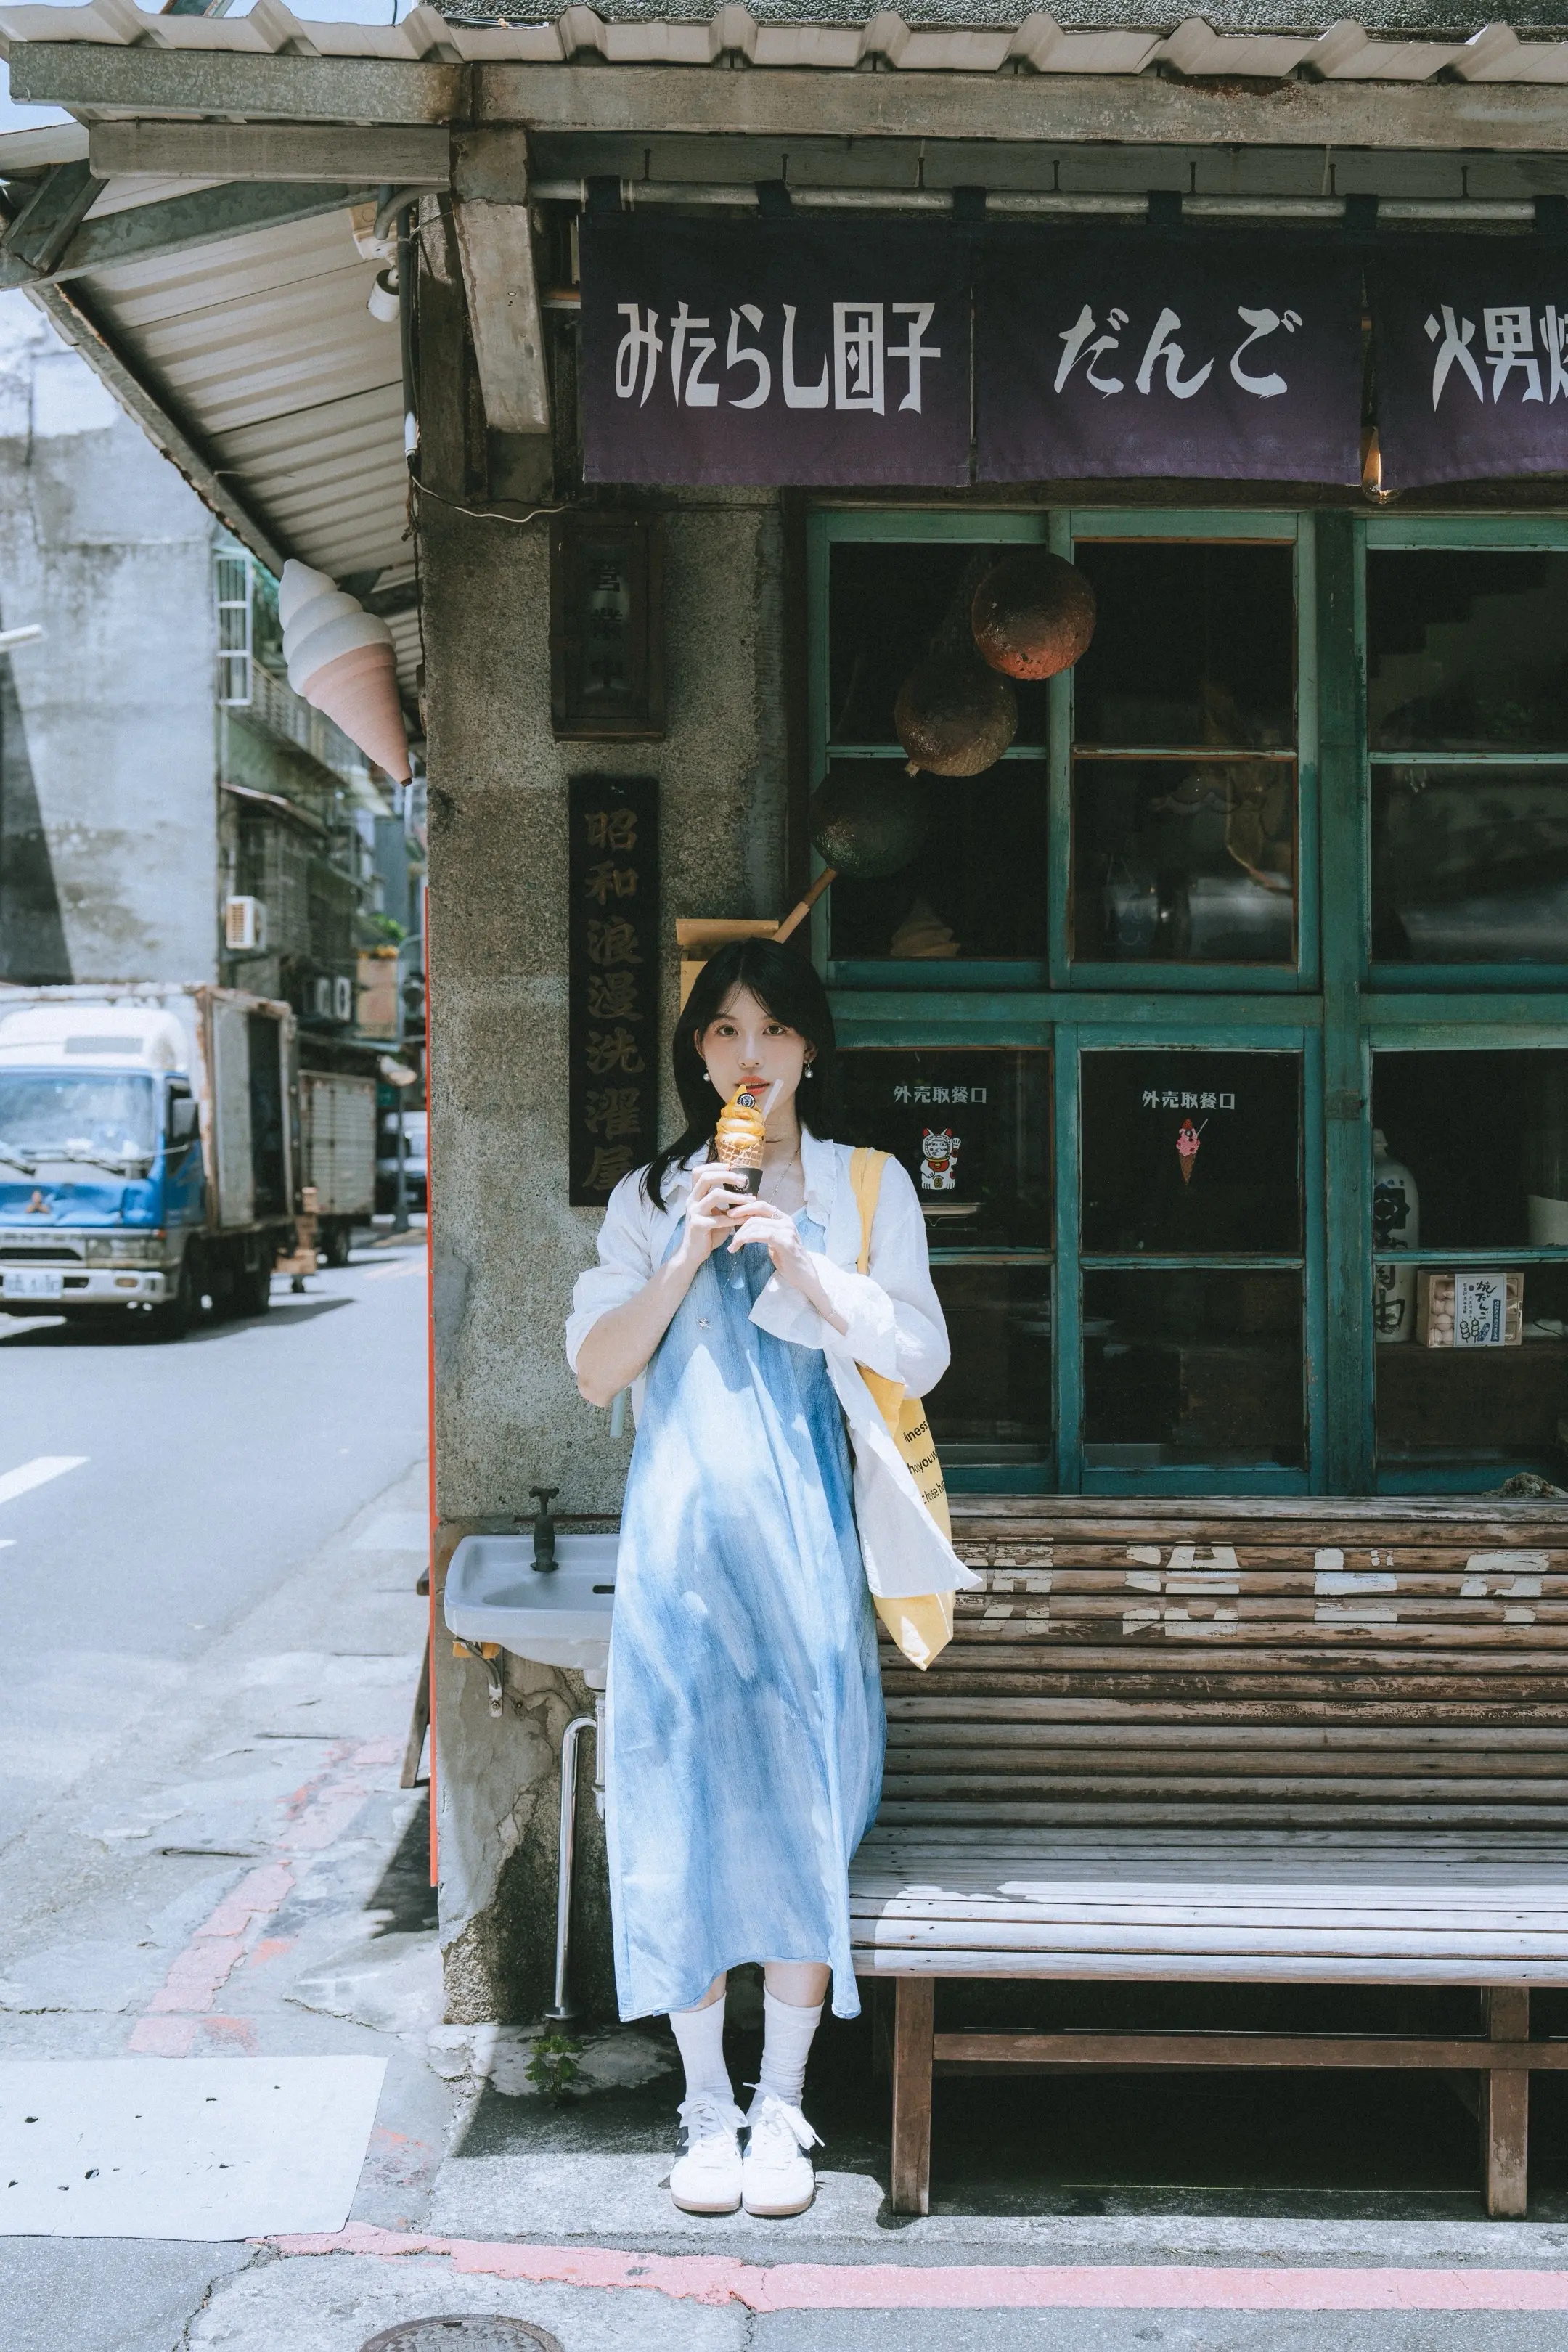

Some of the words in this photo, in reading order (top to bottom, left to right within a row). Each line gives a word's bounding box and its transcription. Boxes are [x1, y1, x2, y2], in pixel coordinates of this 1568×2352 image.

[616, 301, 941, 416] みたらし団子
[1054, 304, 1302, 399] だんご
[582, 808, 645, 1191] 昭和浪漫洗濯屋
[894, 1085, 987, 1104] 外売取餐口
[1142, 1090, 1236, 1110] 外売取餐口
